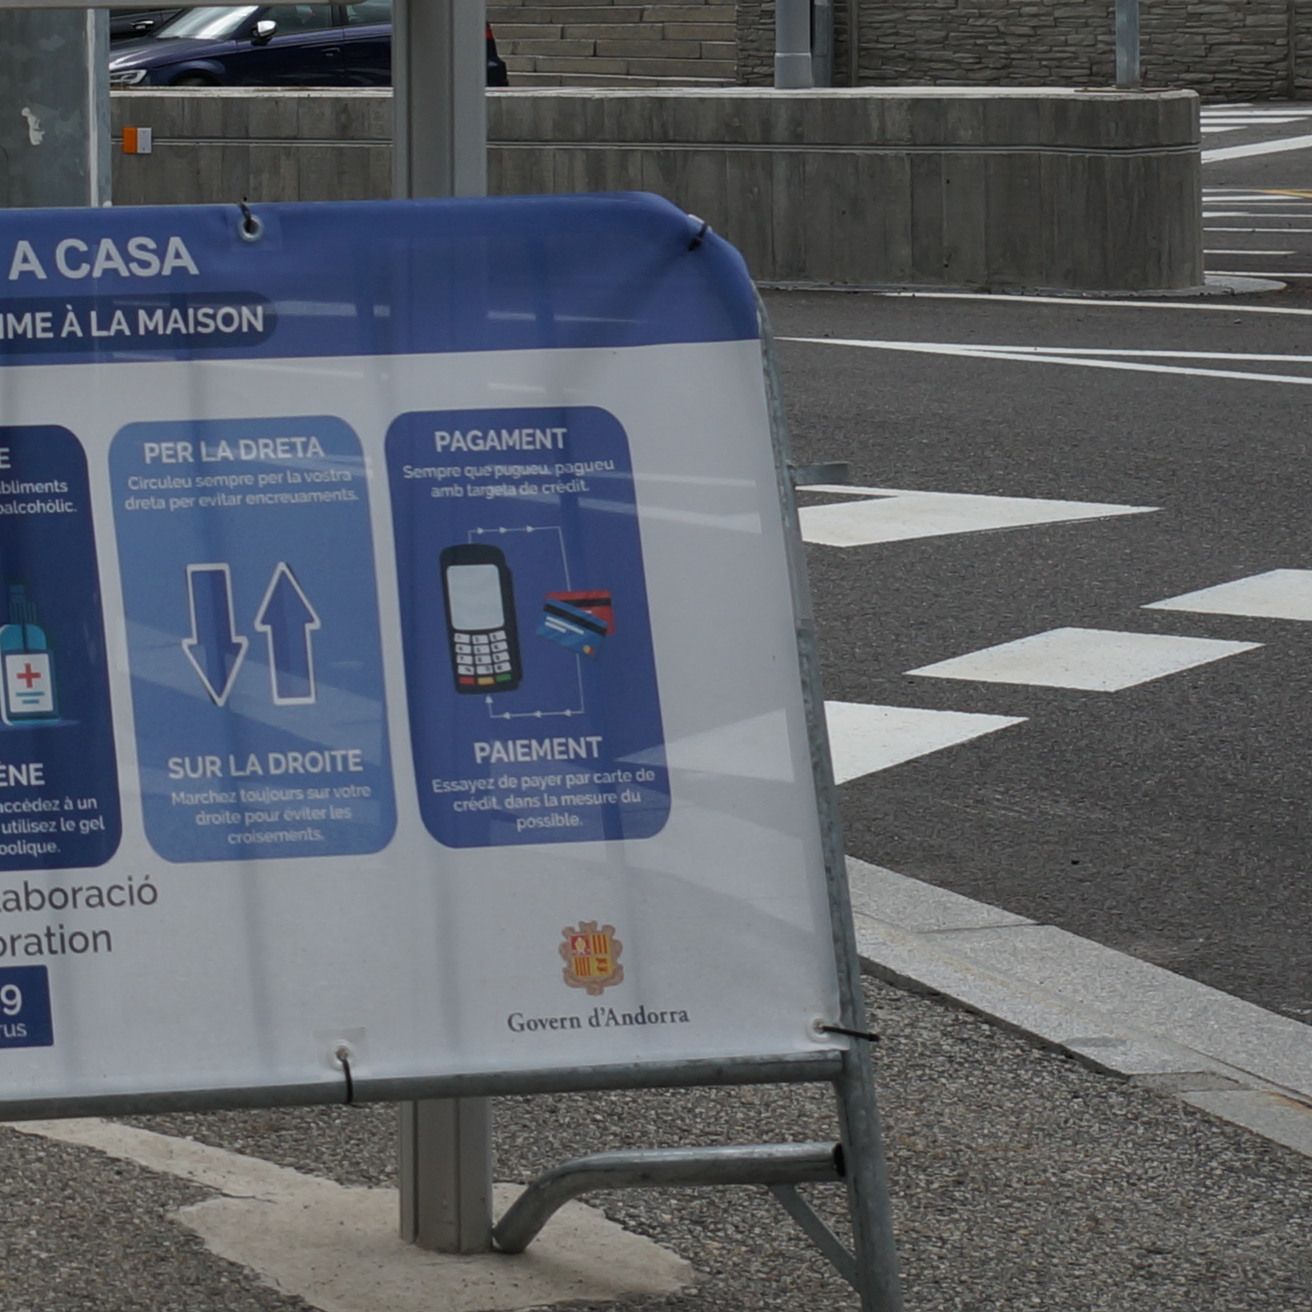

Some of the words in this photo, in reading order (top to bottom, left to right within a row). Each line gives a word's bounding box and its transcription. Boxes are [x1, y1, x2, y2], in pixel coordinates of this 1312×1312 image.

[7, 240, 47, 282] A
[55, 236, 198, 280] CASA
[61, 302, 83, 338] À
[91, 307, 131, 338] LA
[138, 305, 264, 335] MAISON
[144, 442, 194, 465] PER
[201, 440, 233, 462] LA
[239, 436, 324, 461] DRETA
[435, 428, 567, 452] PAGAMENT
[168, 756, 222, 779] SUR
[230, 754, 262, 776] LA
[269, 750, 363, 774] DROITE
[474, 736, 602, 765] PAIEMENT
[64, 797, 74, 811] à
[77, 798, 97, 810] un
[2, 817, 57, 835] utilisez
[61, 817, 76, 831] le
[80, 816, 105, 834] gel
[508, 1012, 581, 1032] Govern
[588, 1005, 690, 1028] d'Andorra
